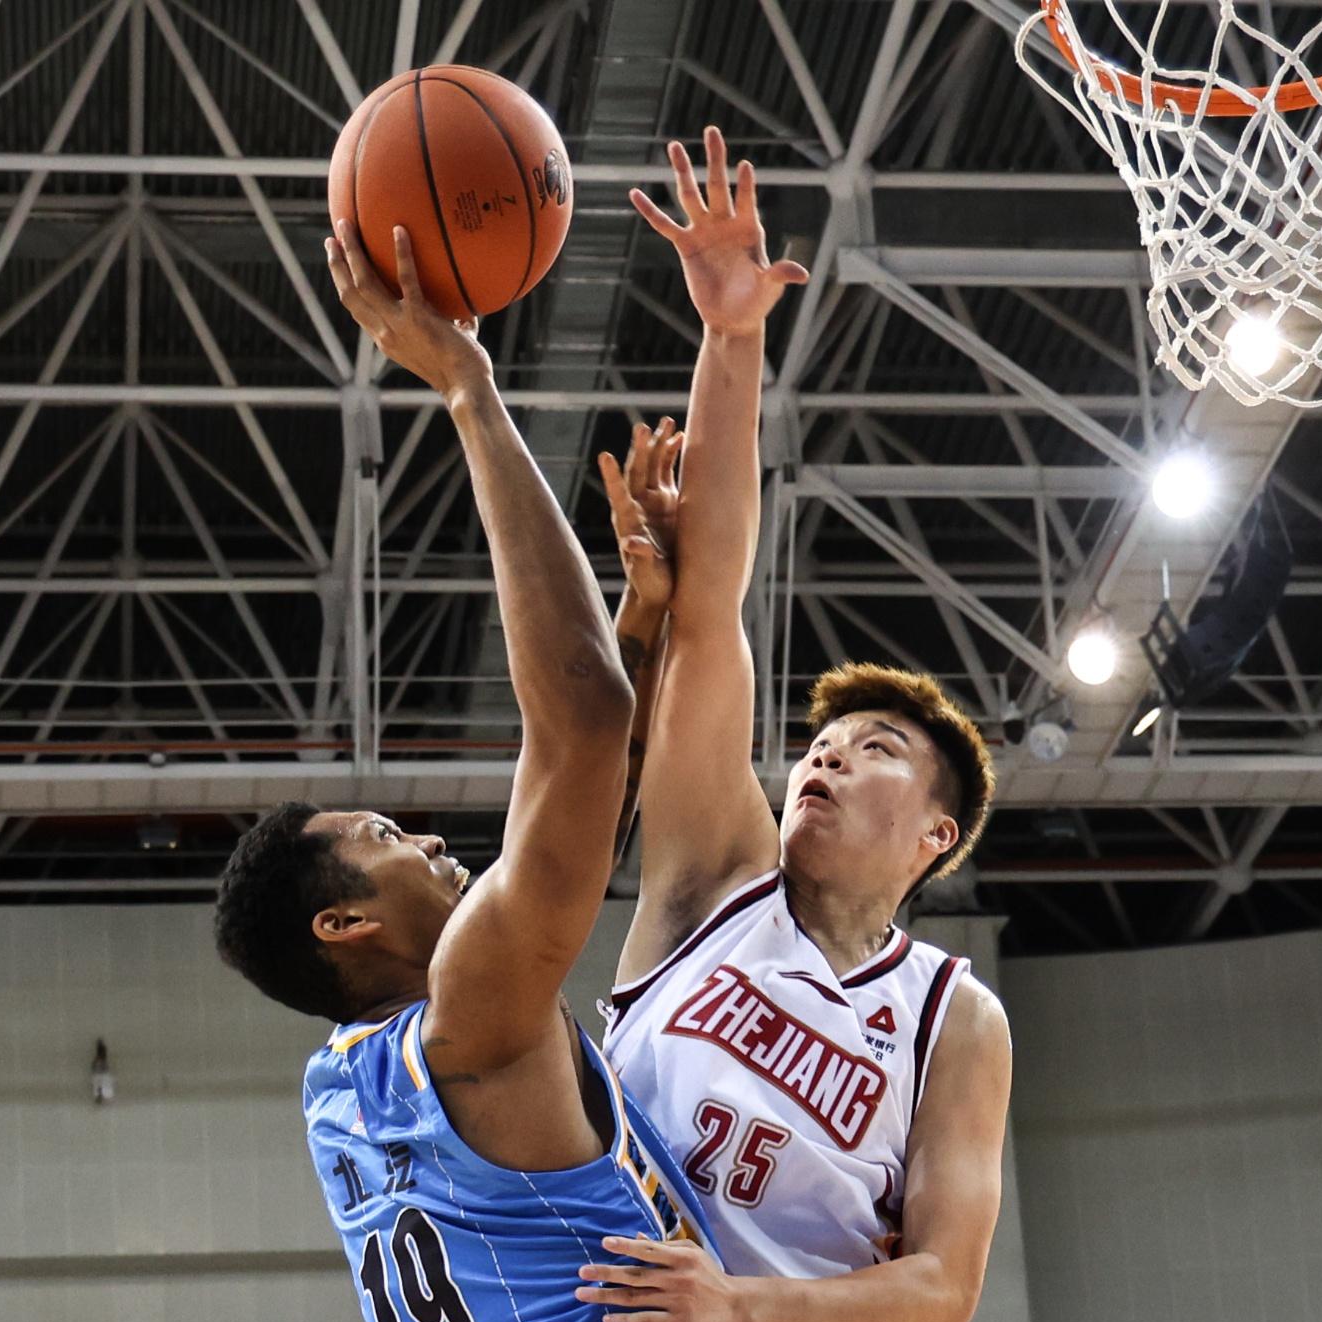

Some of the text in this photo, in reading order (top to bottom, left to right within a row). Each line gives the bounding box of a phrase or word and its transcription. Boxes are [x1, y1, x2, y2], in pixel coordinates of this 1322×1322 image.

[675, 967, 881, 1144] ZHEJIANG
[861, 1032, 896, 1054] 发银行
[683, 1099, 791, 1208] 25
